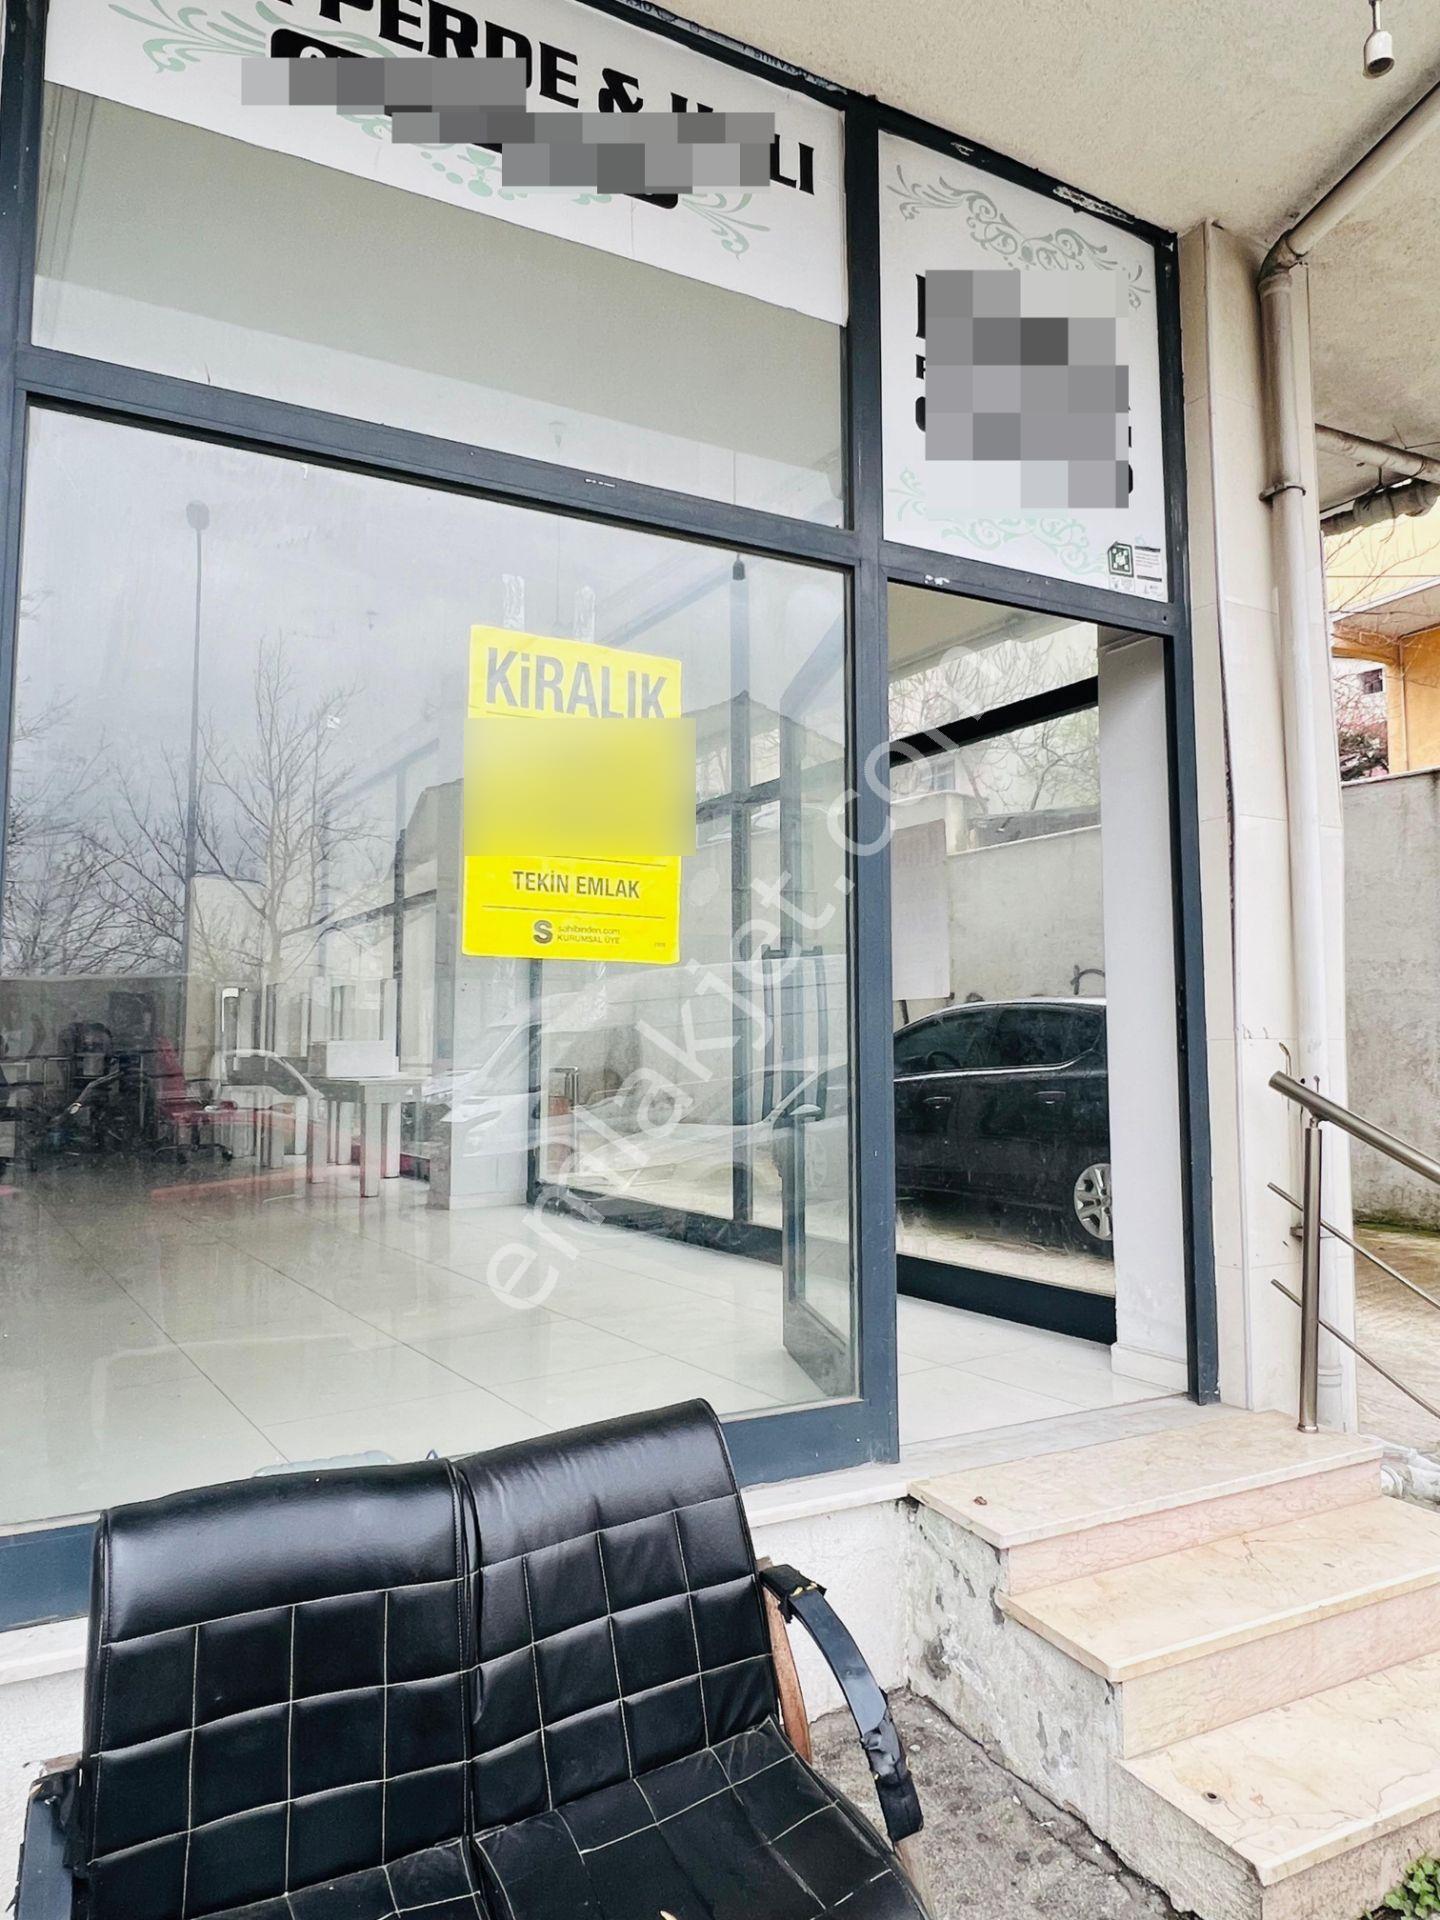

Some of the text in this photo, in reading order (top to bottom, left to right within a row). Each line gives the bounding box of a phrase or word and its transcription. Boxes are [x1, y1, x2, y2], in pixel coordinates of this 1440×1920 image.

[513, 869, 640, 899] TEKİN EMLAK
[557, 934, 602, 943] KURUMSAL
